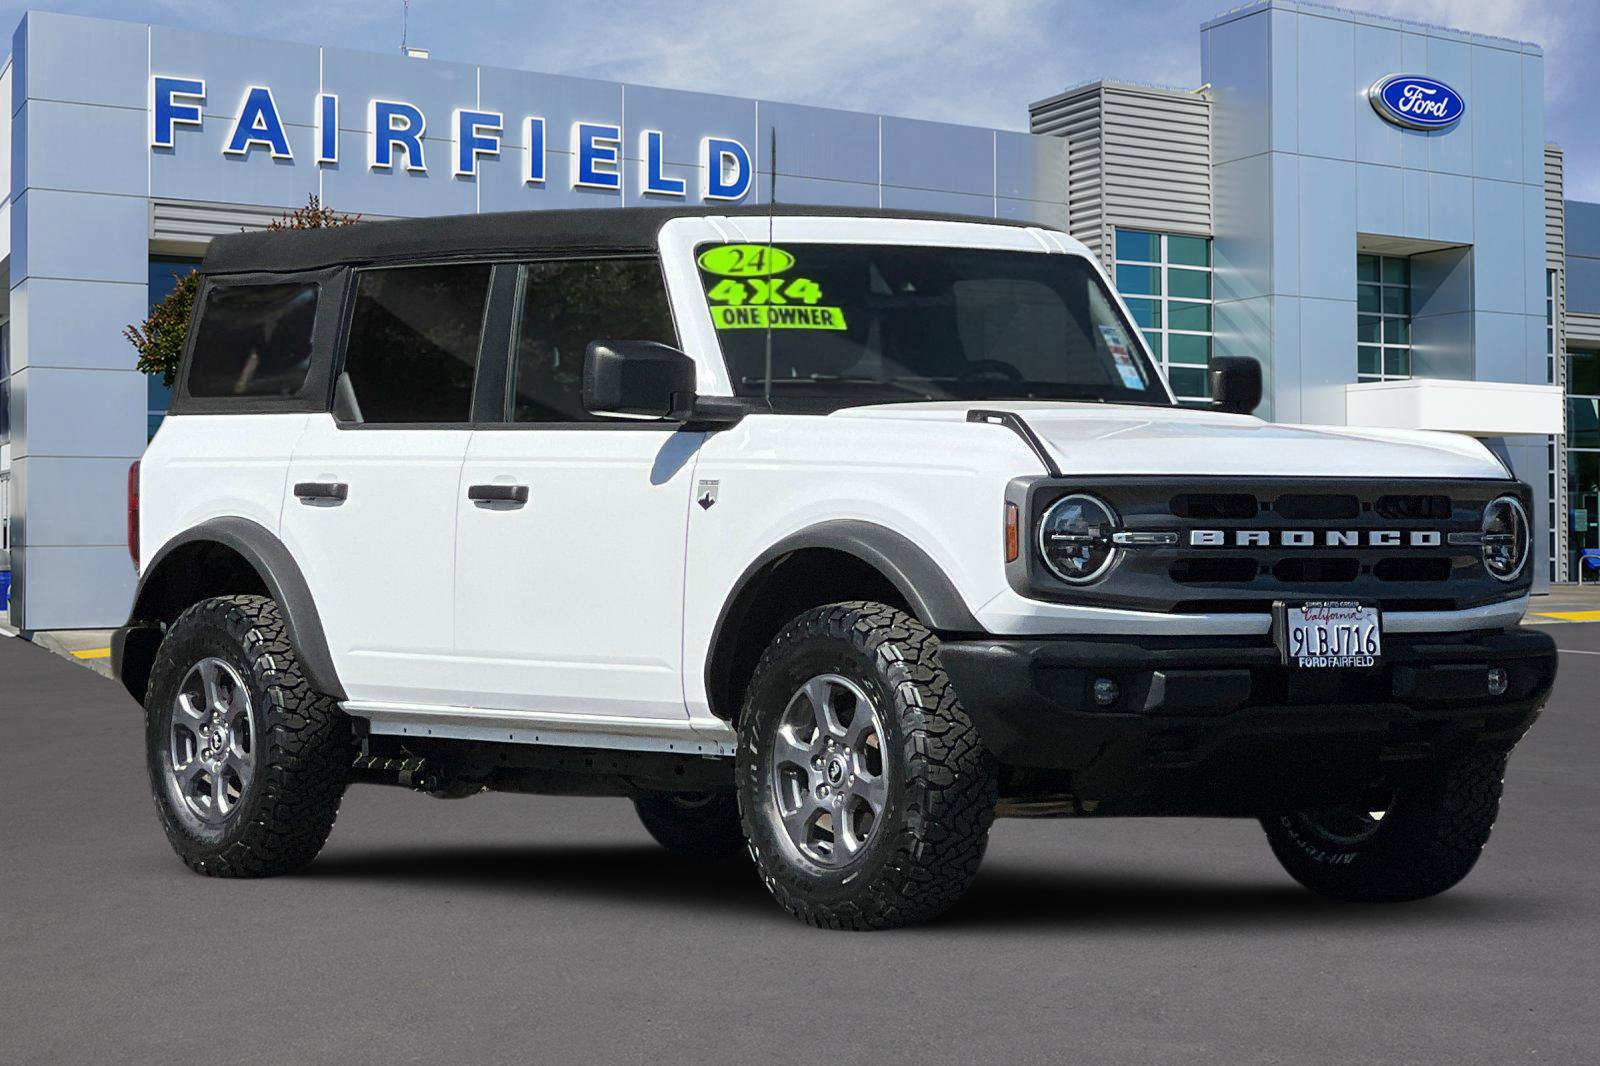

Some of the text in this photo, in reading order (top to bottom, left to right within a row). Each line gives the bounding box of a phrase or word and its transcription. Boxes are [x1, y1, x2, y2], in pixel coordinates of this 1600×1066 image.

[1399, 84, 1448, 117] Ford
[151, 75, 752, 200] FAIRFIELD
[728, 249, 766, 273] 24
[723, 308, 833, 326] ONE OWNER
[1190, 530, 1441, 546] BRONCO
[1304, 607, 1362, 625] California
[1293, 626, 1377, 656] 9LBJ716
[1300, 656, 1375, 668] FORD FAIRFIELD
